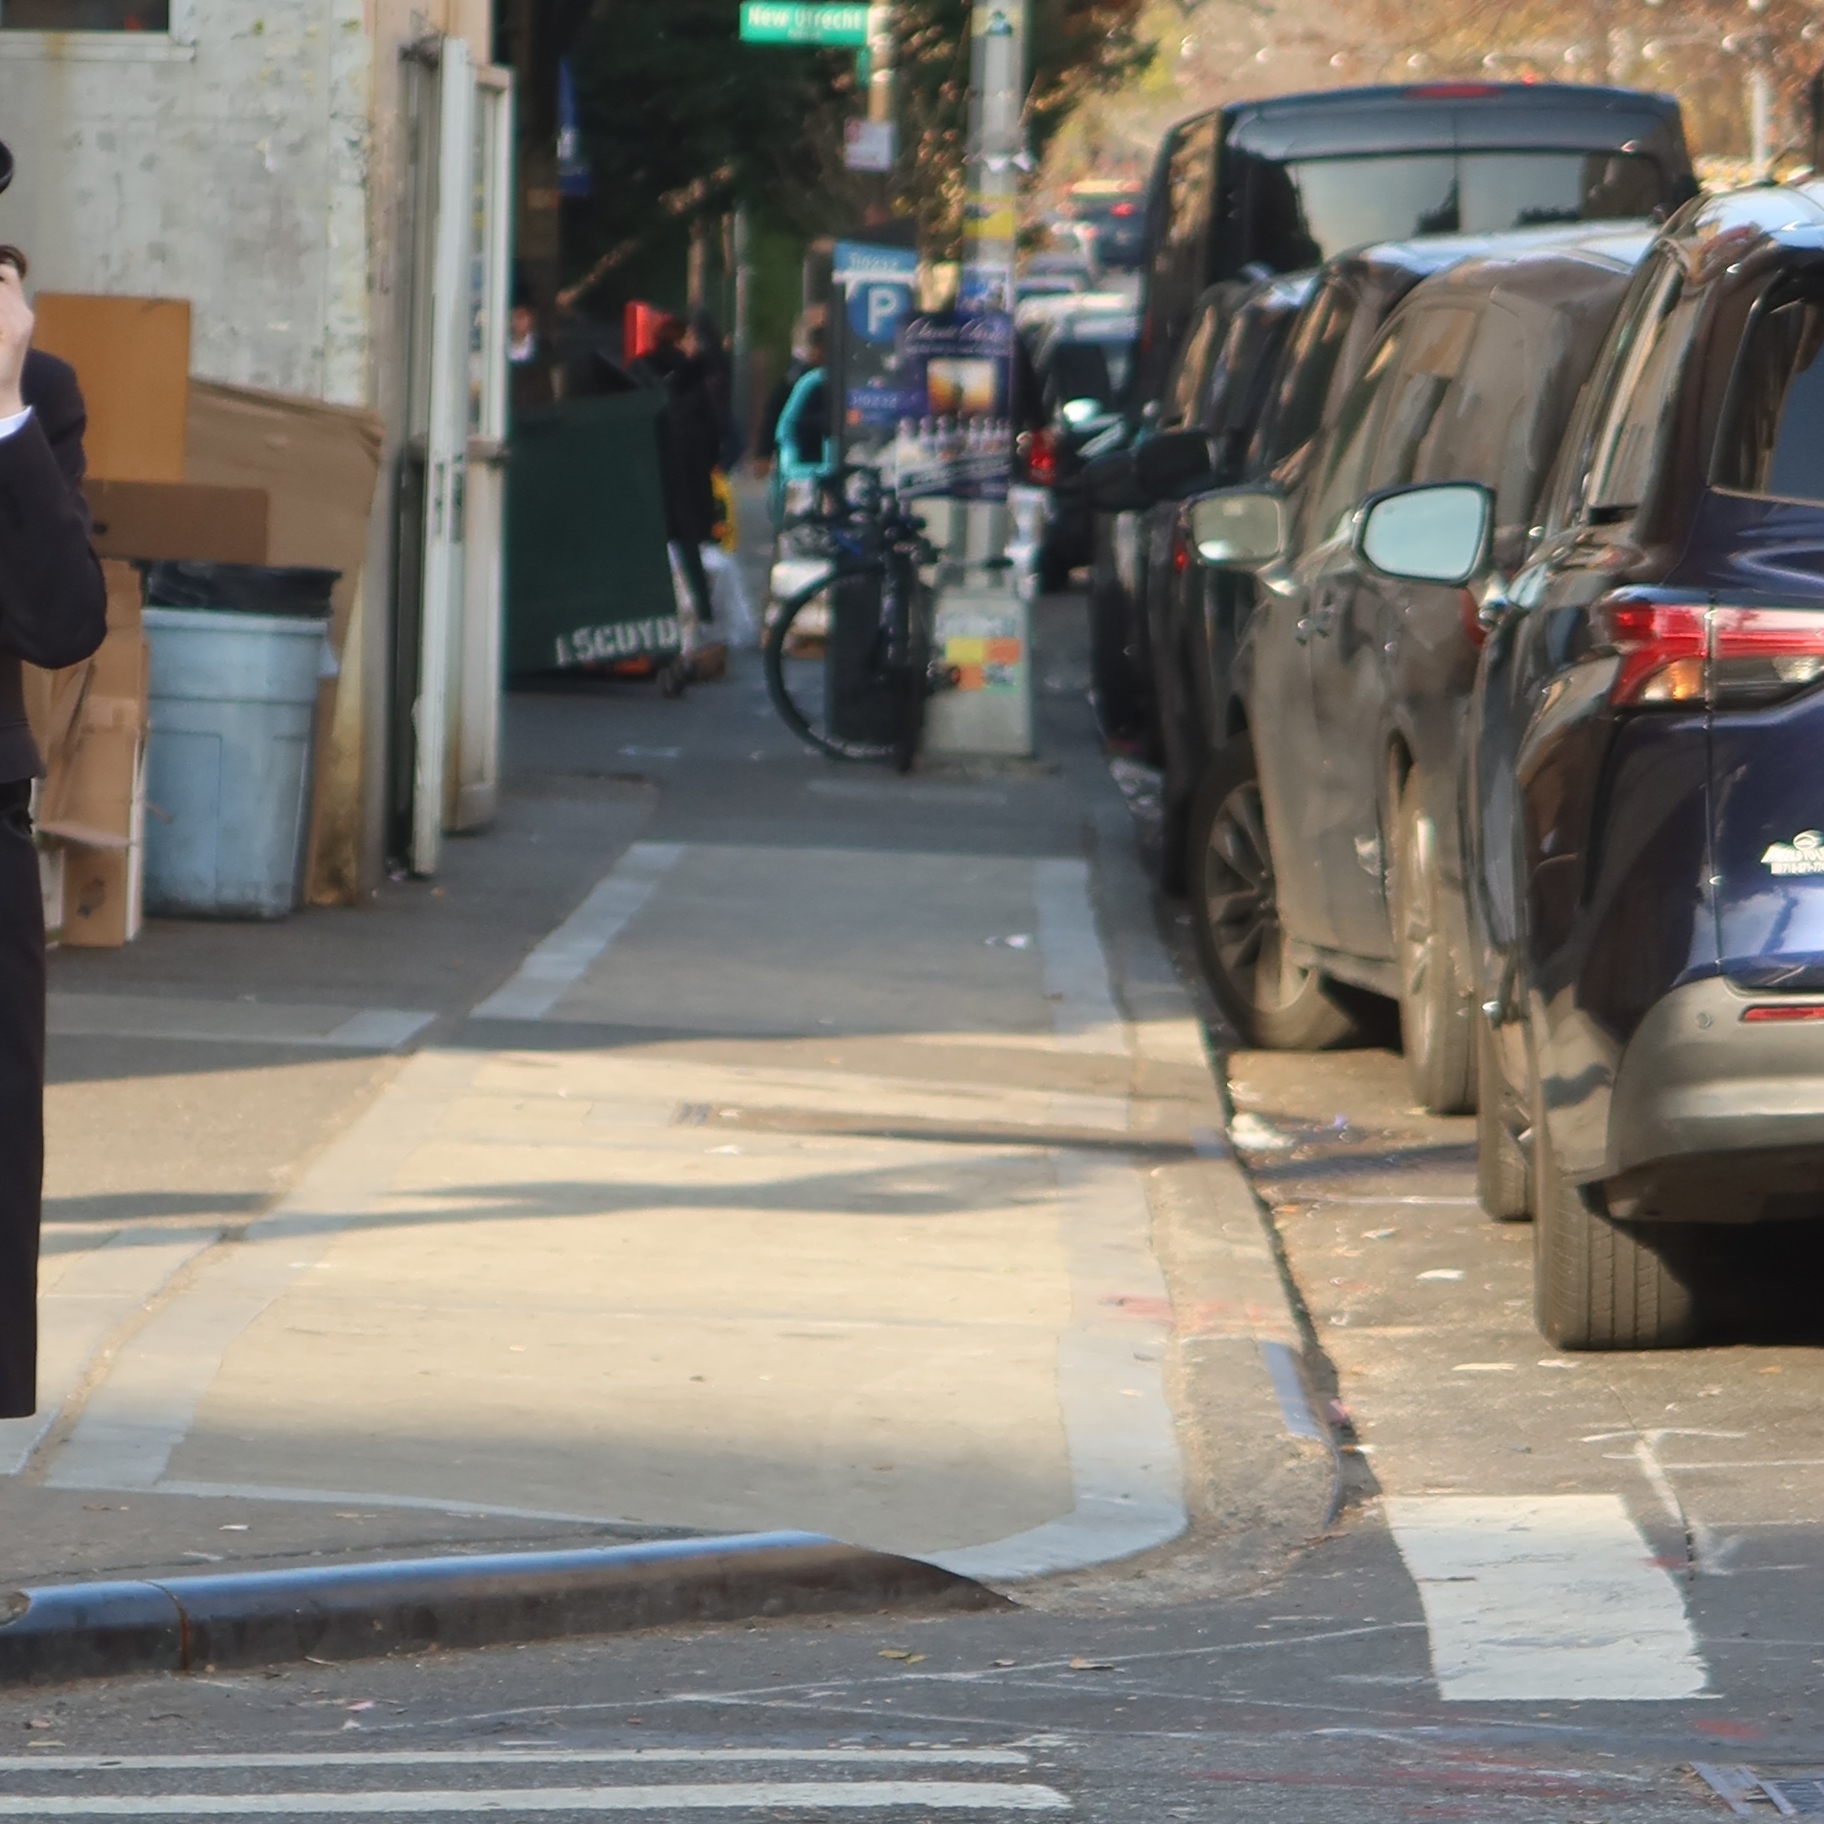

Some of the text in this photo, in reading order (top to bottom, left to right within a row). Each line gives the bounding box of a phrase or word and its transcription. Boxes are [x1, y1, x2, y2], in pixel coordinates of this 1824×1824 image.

[748, 5, 862, 30] New Utrecht
[868, 288, 897, 335] P
